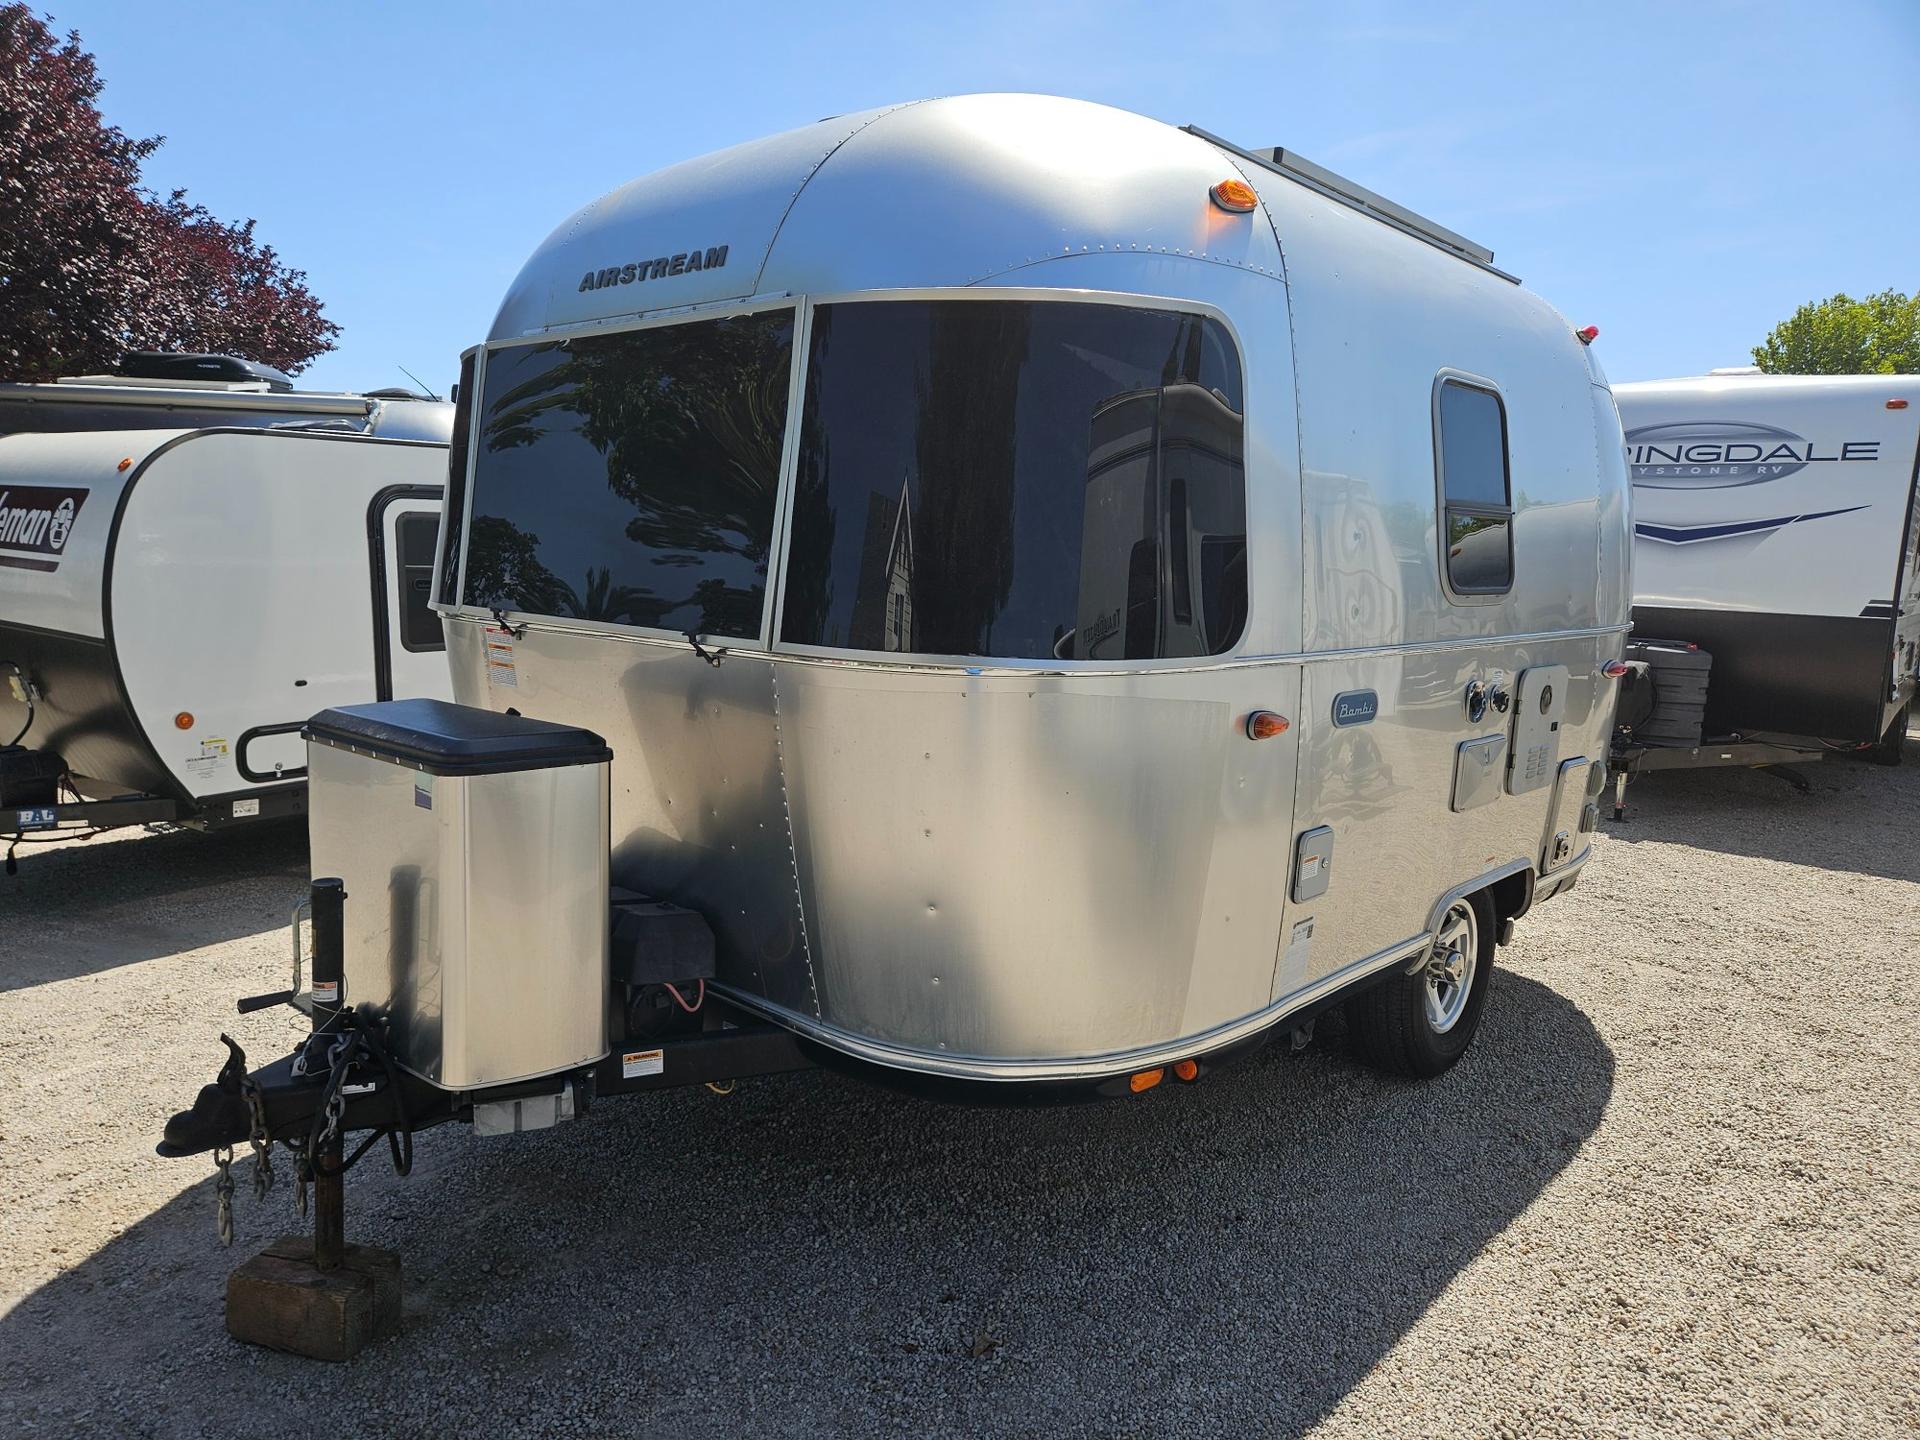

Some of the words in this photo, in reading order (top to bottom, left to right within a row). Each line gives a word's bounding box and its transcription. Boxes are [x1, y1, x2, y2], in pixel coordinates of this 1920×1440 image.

[578, 245, 729, 292] AIRSTREAM
[1627, 442, 1881, 463] INGDALE
[1757, 466, 1782, 474] RV
[1340, 701, 1374, 718] Bambi
